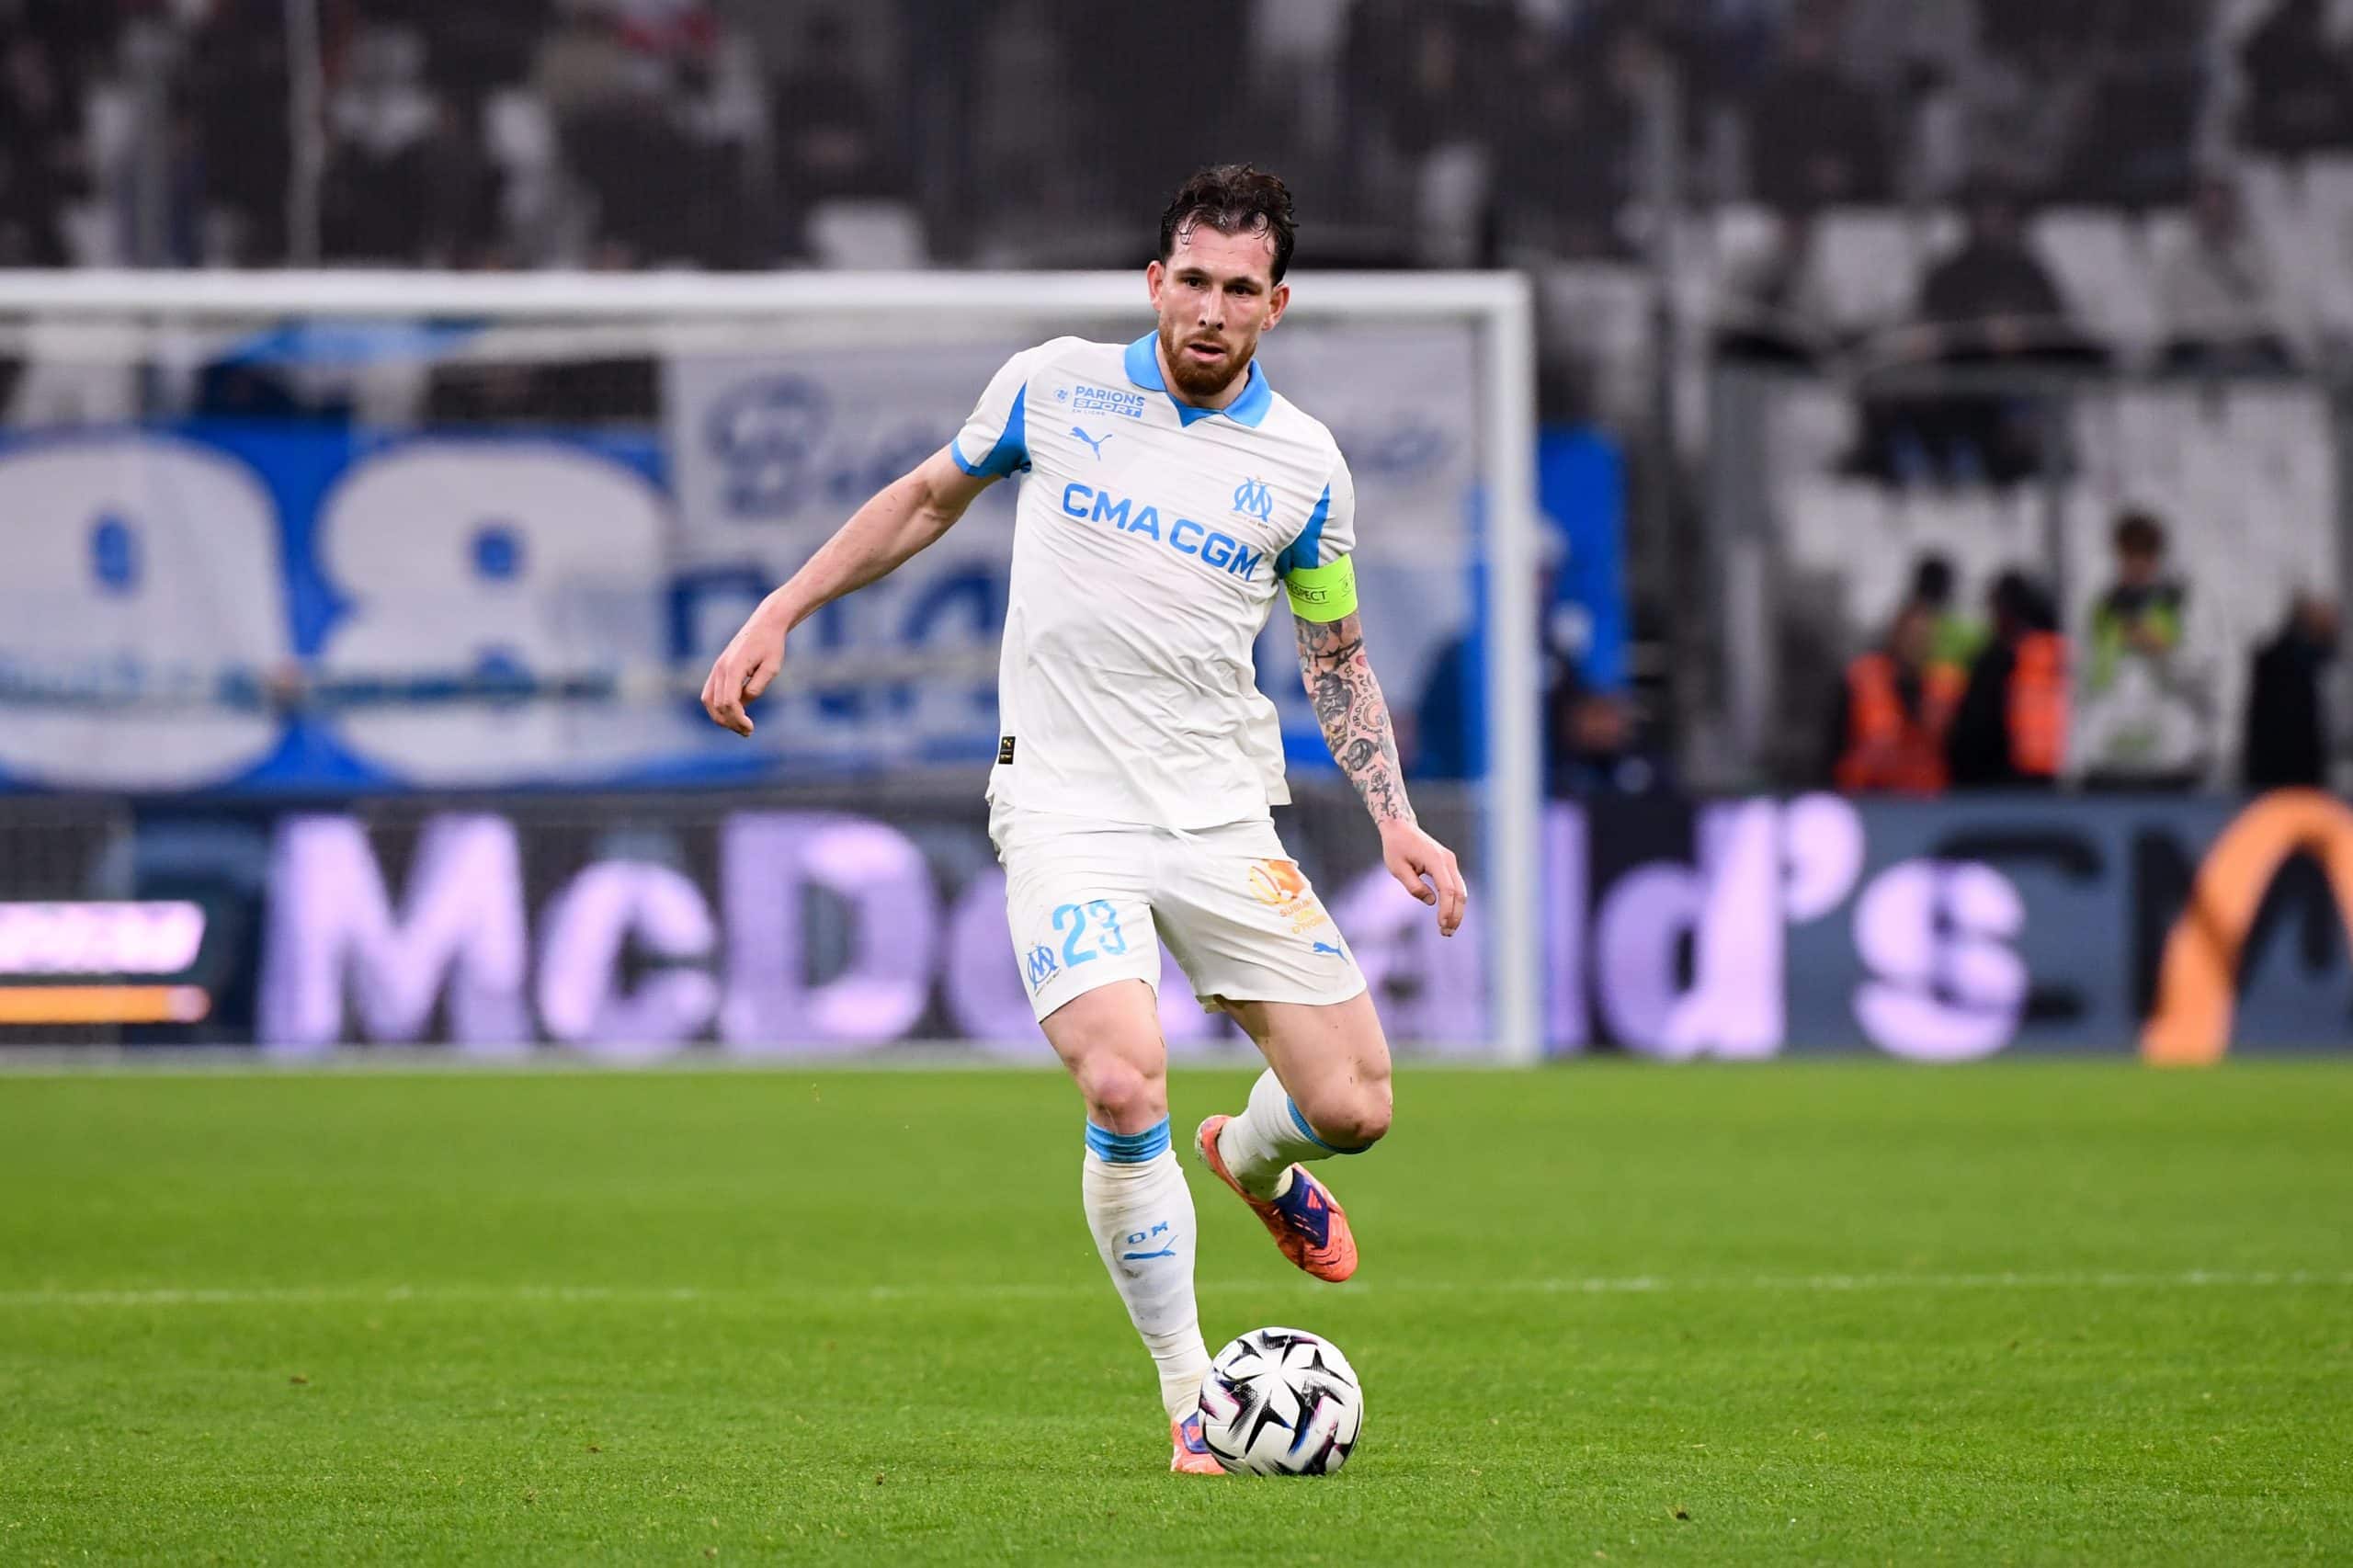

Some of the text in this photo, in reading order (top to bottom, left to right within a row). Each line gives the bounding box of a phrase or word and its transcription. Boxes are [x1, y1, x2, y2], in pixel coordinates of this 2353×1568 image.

[1074, 397, 1142, 418] SPORT
[1075, 385, 1146, 406] PARIONS
[1062, 483, 1264, 582] CMA CGM
[259, 812, 2029, 1062] McDald's
[1051, 900, 1127, 968] 23
